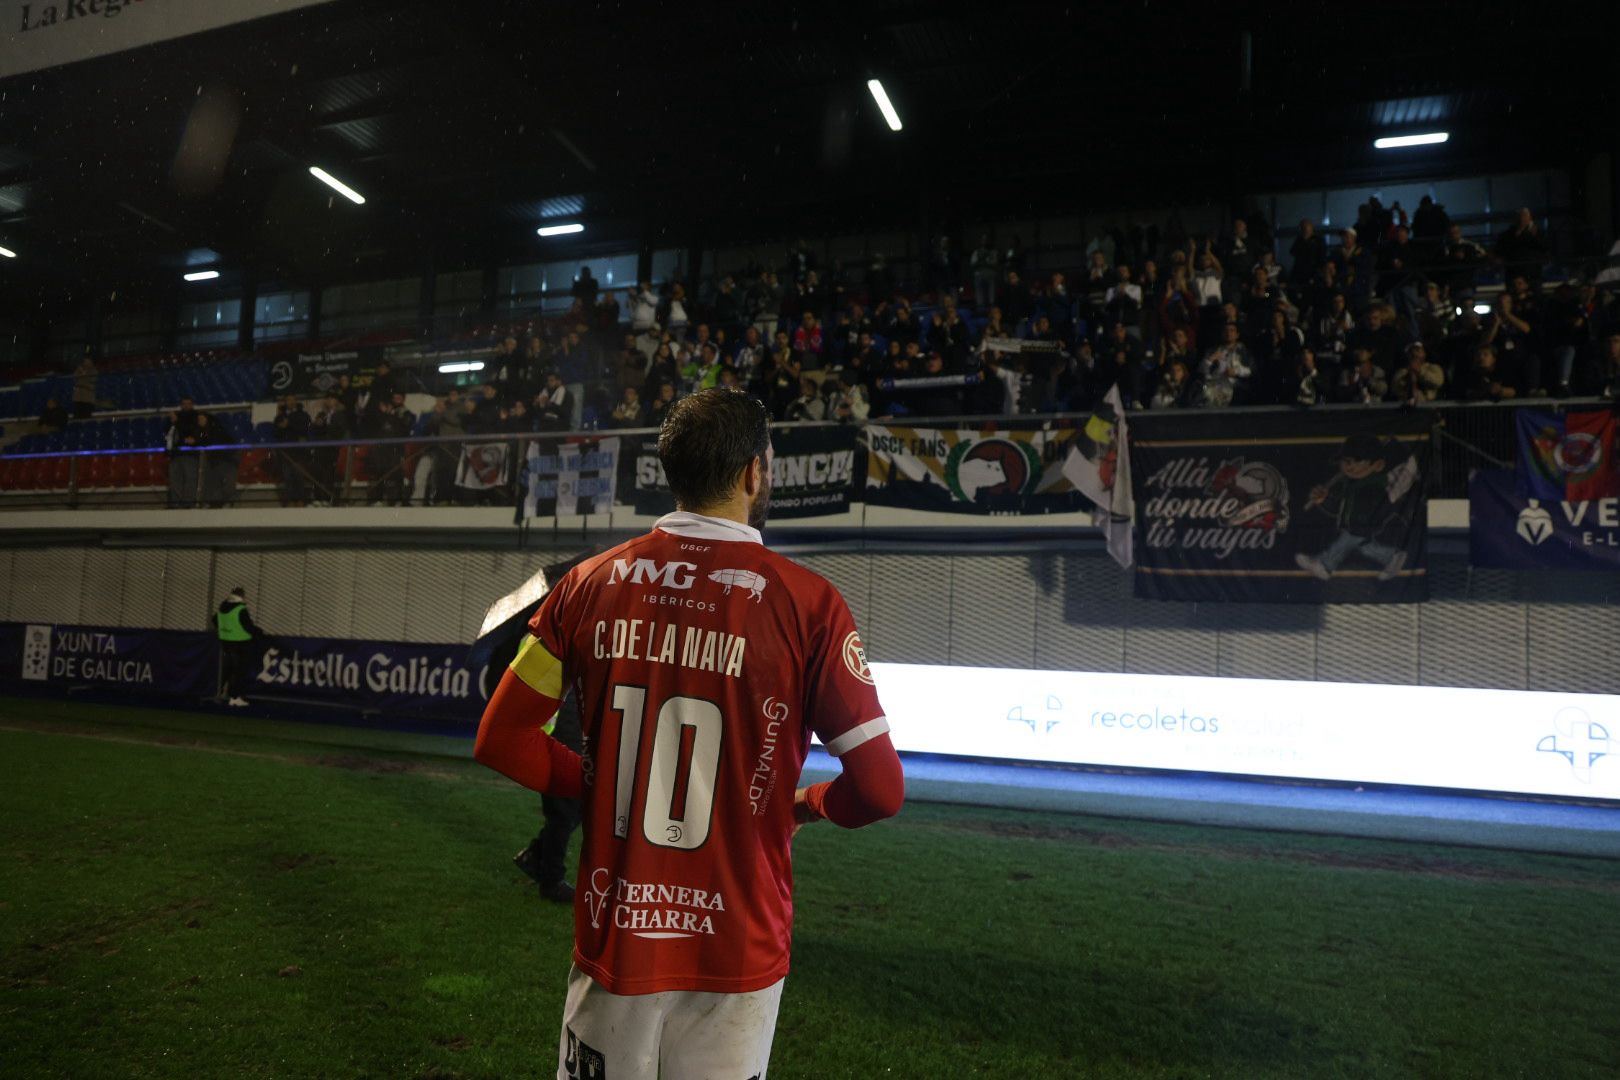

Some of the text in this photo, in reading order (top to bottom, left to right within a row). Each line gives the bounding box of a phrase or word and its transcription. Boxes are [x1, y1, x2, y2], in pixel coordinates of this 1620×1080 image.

[20, 4, 58, 32] La
[1145, 457, 1210, 488] Allá
[1145, 489, 1240, 520] donde
[680, 543, 711, 552] USCF
[1146, 521, 1277, 560] tú vayas
[606, 558, 698, 590] MMG
[56, 632, 117, 655] XUNTA
[645, 621, 677, 665] LA
[681, 626, 747, 678] NAVA
[52, 656, 153, 684] DE GALICIA
[256, 647, 361, 691] Estrella
[365, 652, 471, 699] Galicia
[1091, 707, 1219, 734] recoletas
[612, 684, 723, 850] 10
[616, 877, 725, 912] TERNERA
[614, 904, 715, 934] CHARRA
